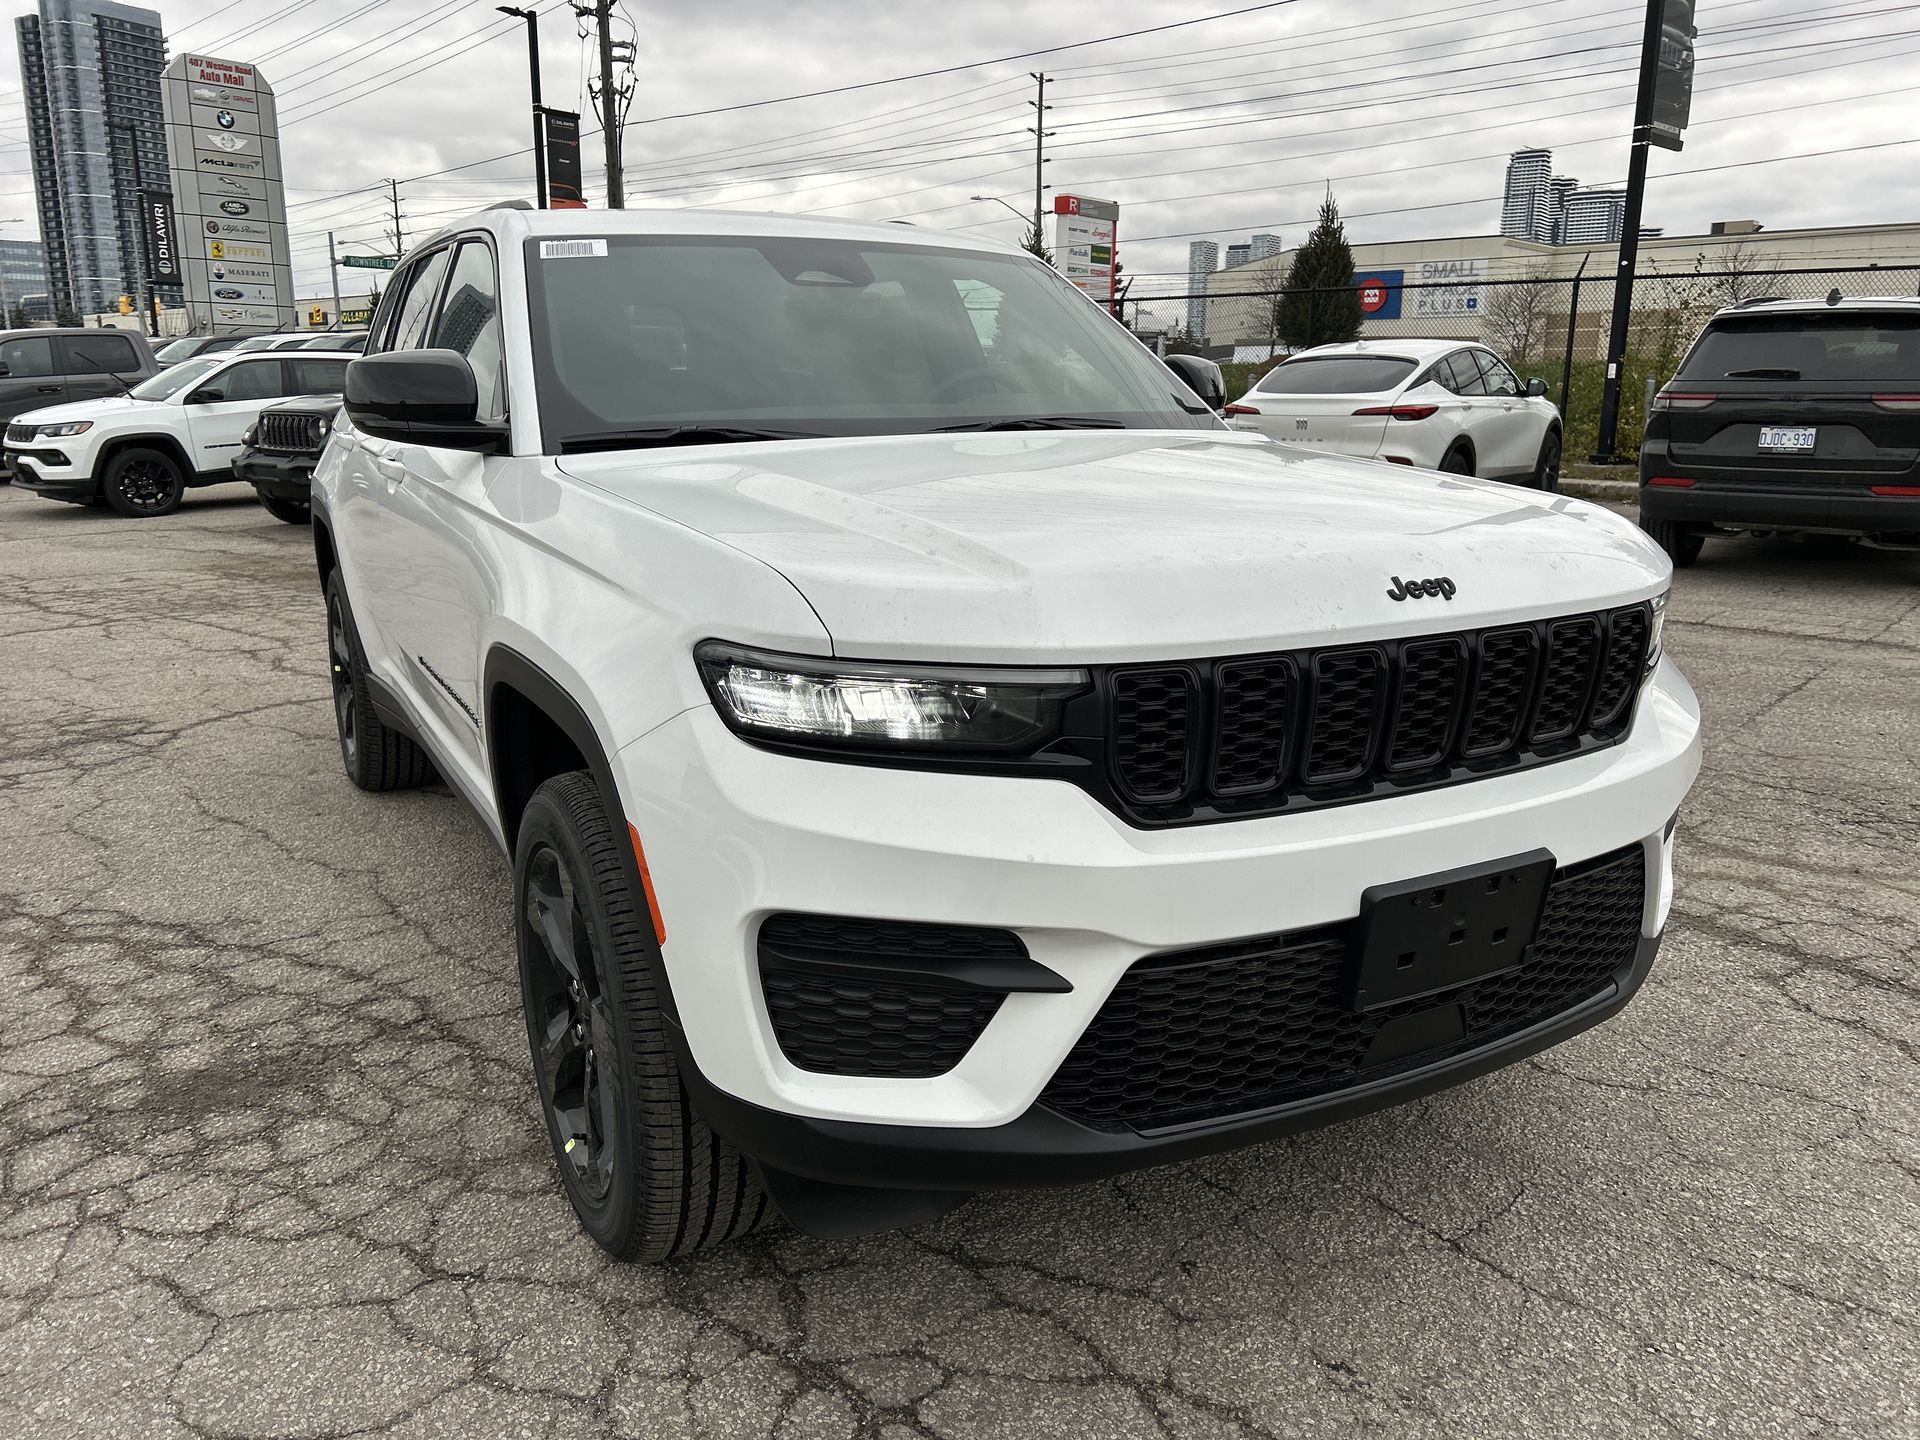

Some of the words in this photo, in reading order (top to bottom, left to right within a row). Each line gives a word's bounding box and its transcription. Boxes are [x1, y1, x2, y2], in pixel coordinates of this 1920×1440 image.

[205, 60, 233, 72] Weston
[234, 65, 252, 76] Road
[199, 69, 221, 83] Auto
[223, 73, 245, 87] Mall
[232, 95, 255, 104] GMC
[153, 203, 170, 258] DILAWRI
[350, 258, 384, 269] ROWNTREE
[1421, 261, 1480, 279] SMALL
[228, 269, 270, 278] MASERATI
[1386, 575, 1457, 602] Jeep
